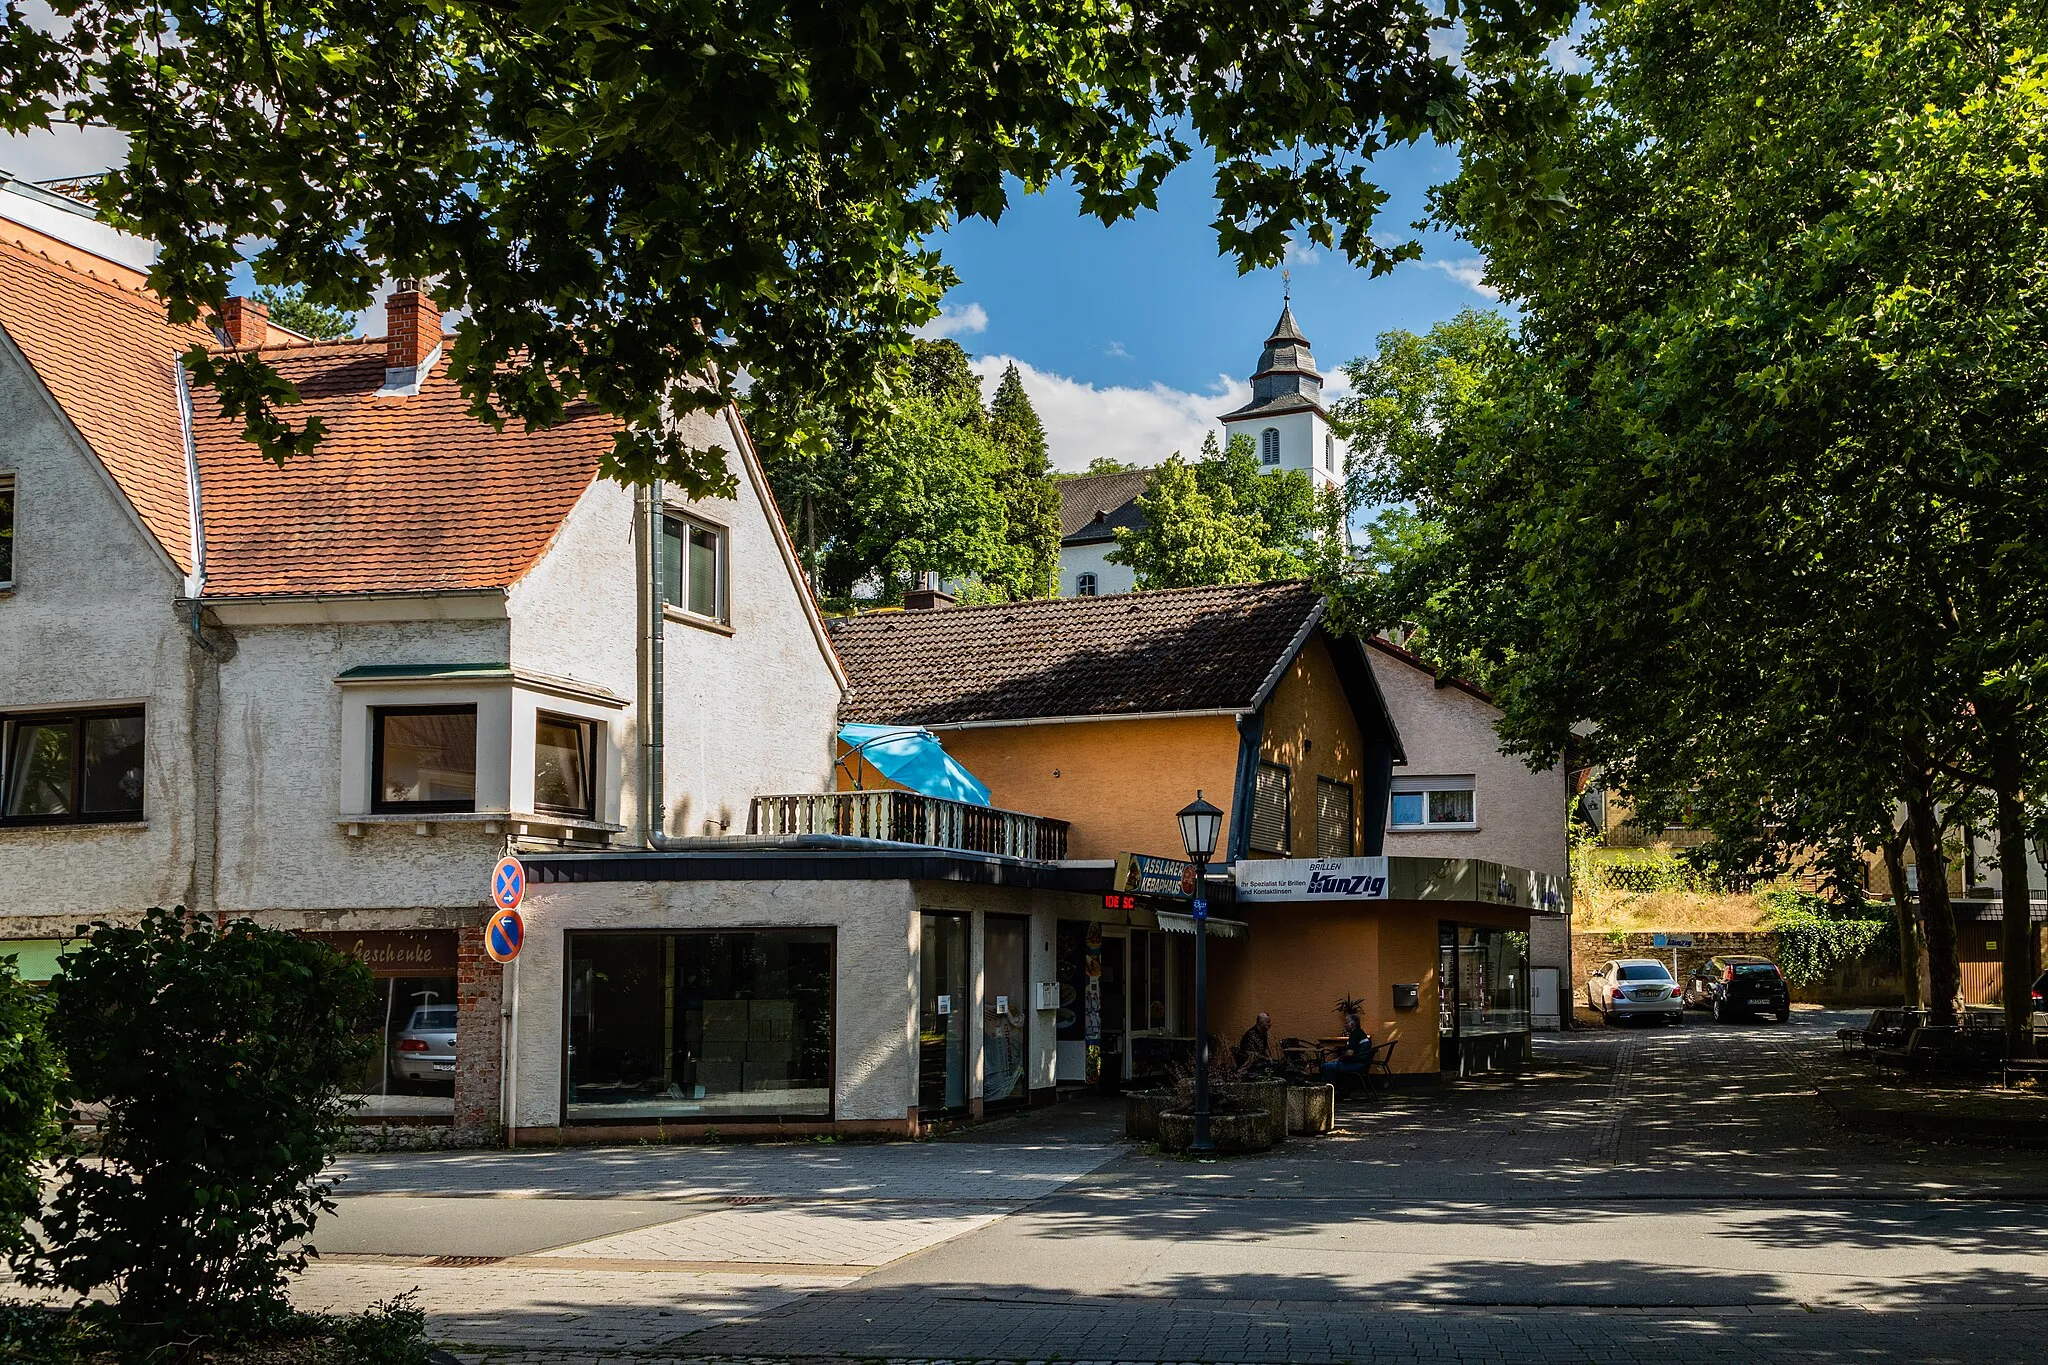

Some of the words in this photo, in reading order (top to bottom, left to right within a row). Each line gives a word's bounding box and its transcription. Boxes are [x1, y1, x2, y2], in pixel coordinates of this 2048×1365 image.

[1143, 858, 1184, 877] ASSLARER
[1309, 863, 1341, 871] BRILLEN
[1140, 877, 1182, 895] KEBAPHAUS
[352, 939, 432, 962] Geschenke
